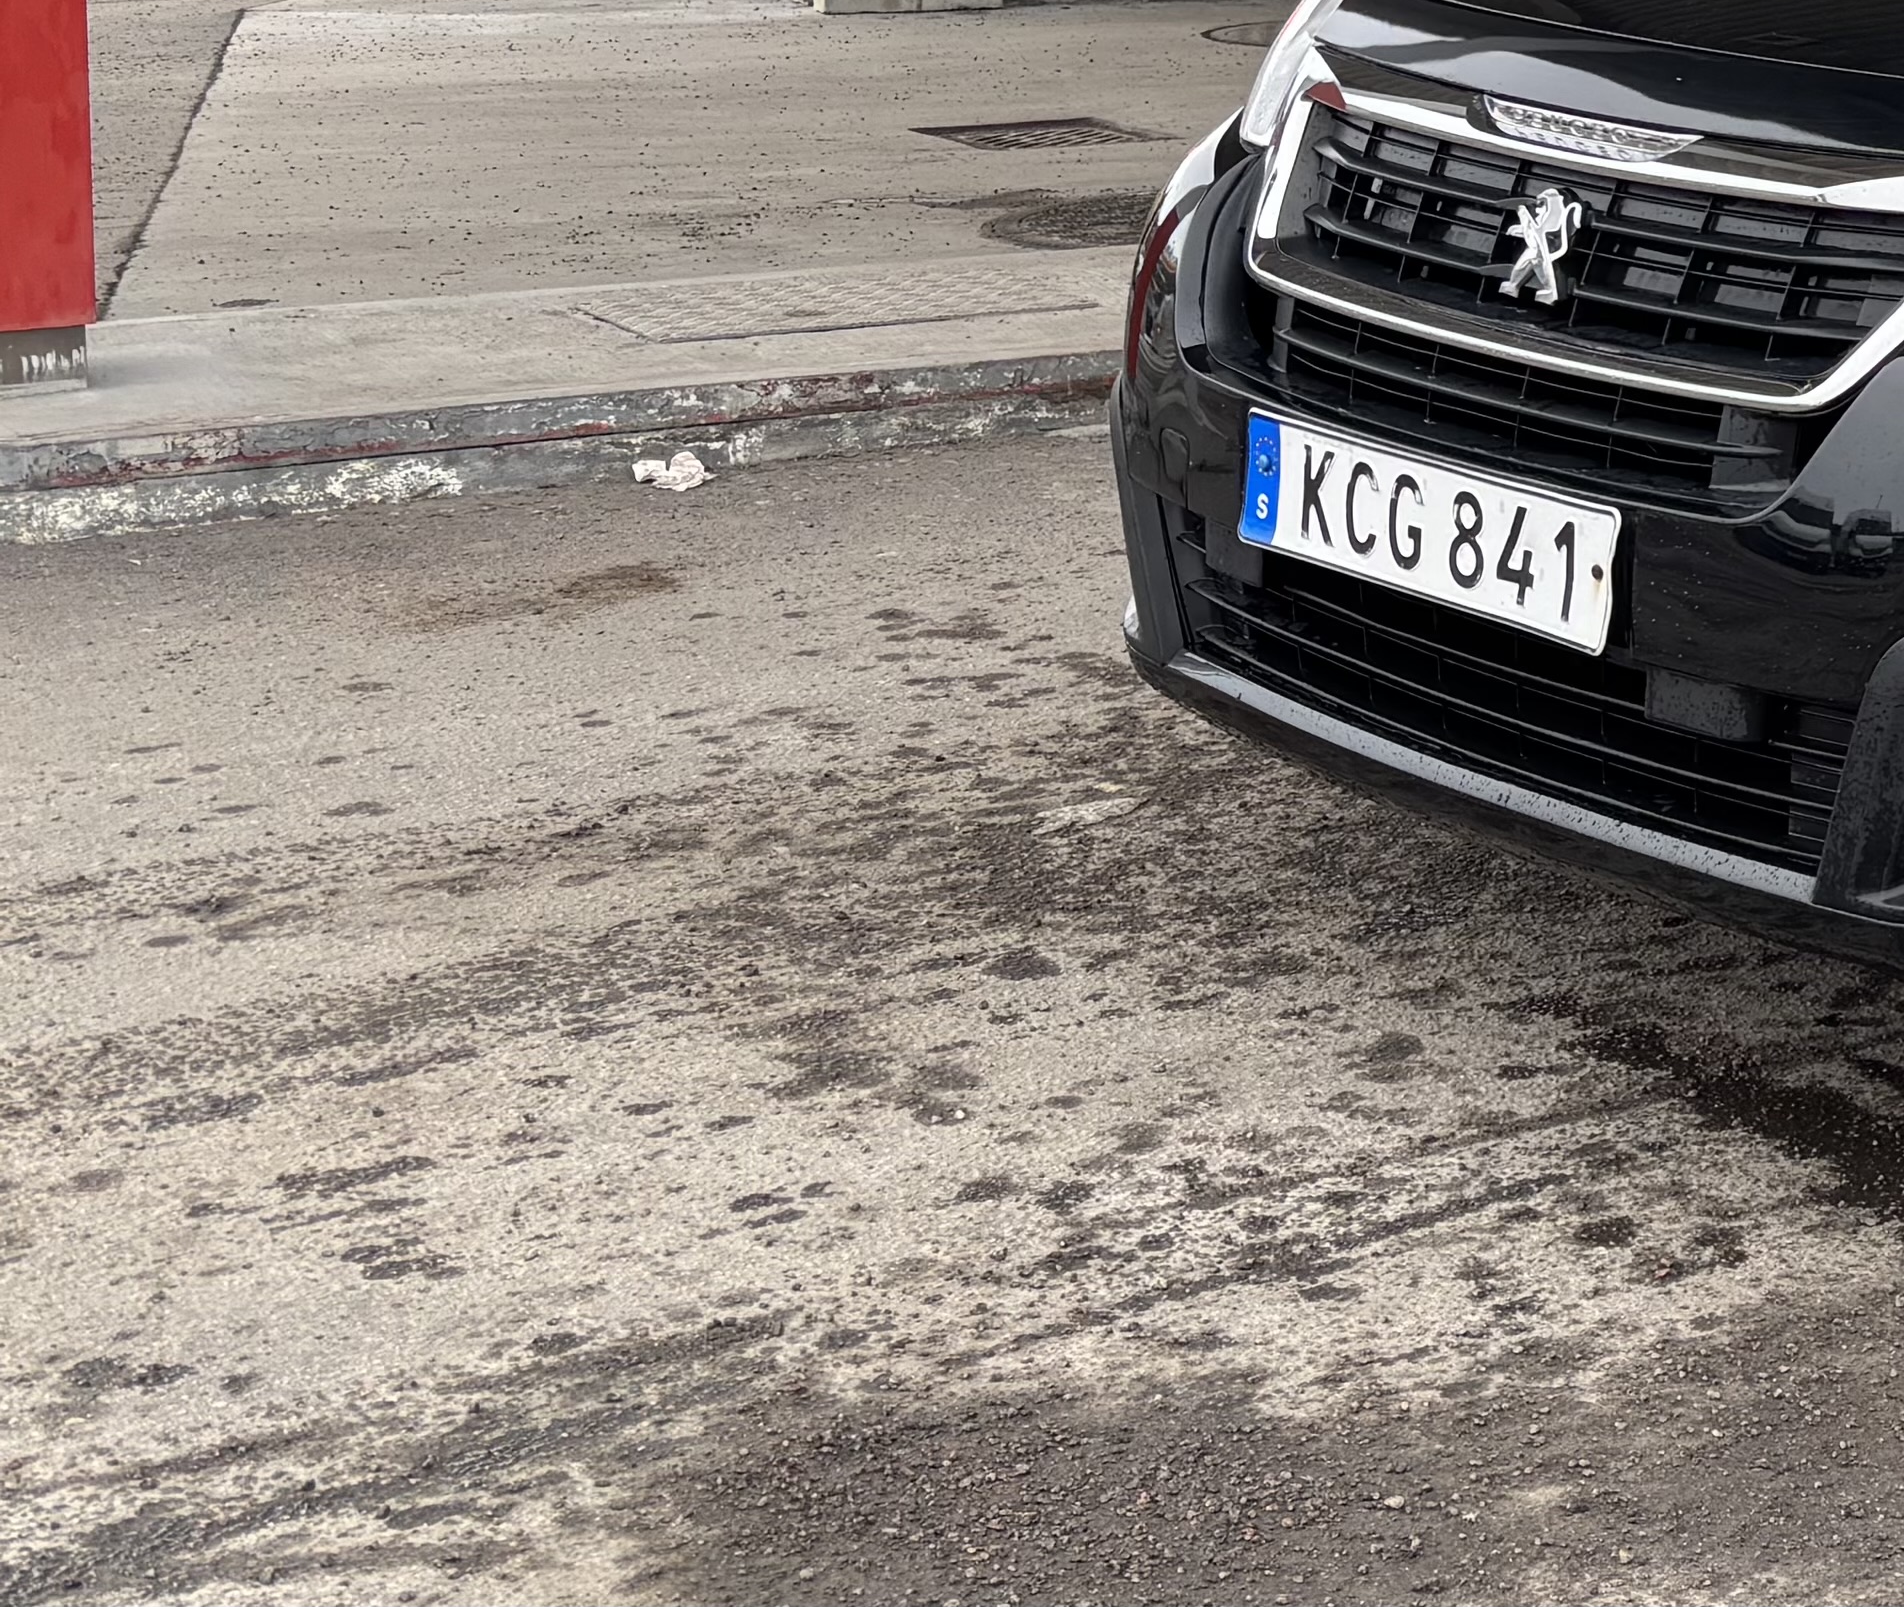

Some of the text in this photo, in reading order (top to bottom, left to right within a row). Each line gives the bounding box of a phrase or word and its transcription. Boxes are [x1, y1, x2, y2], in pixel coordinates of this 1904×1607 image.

[1255, 493, 1269, 521] S
[1300, 442, 1578, 624] KCG 841
